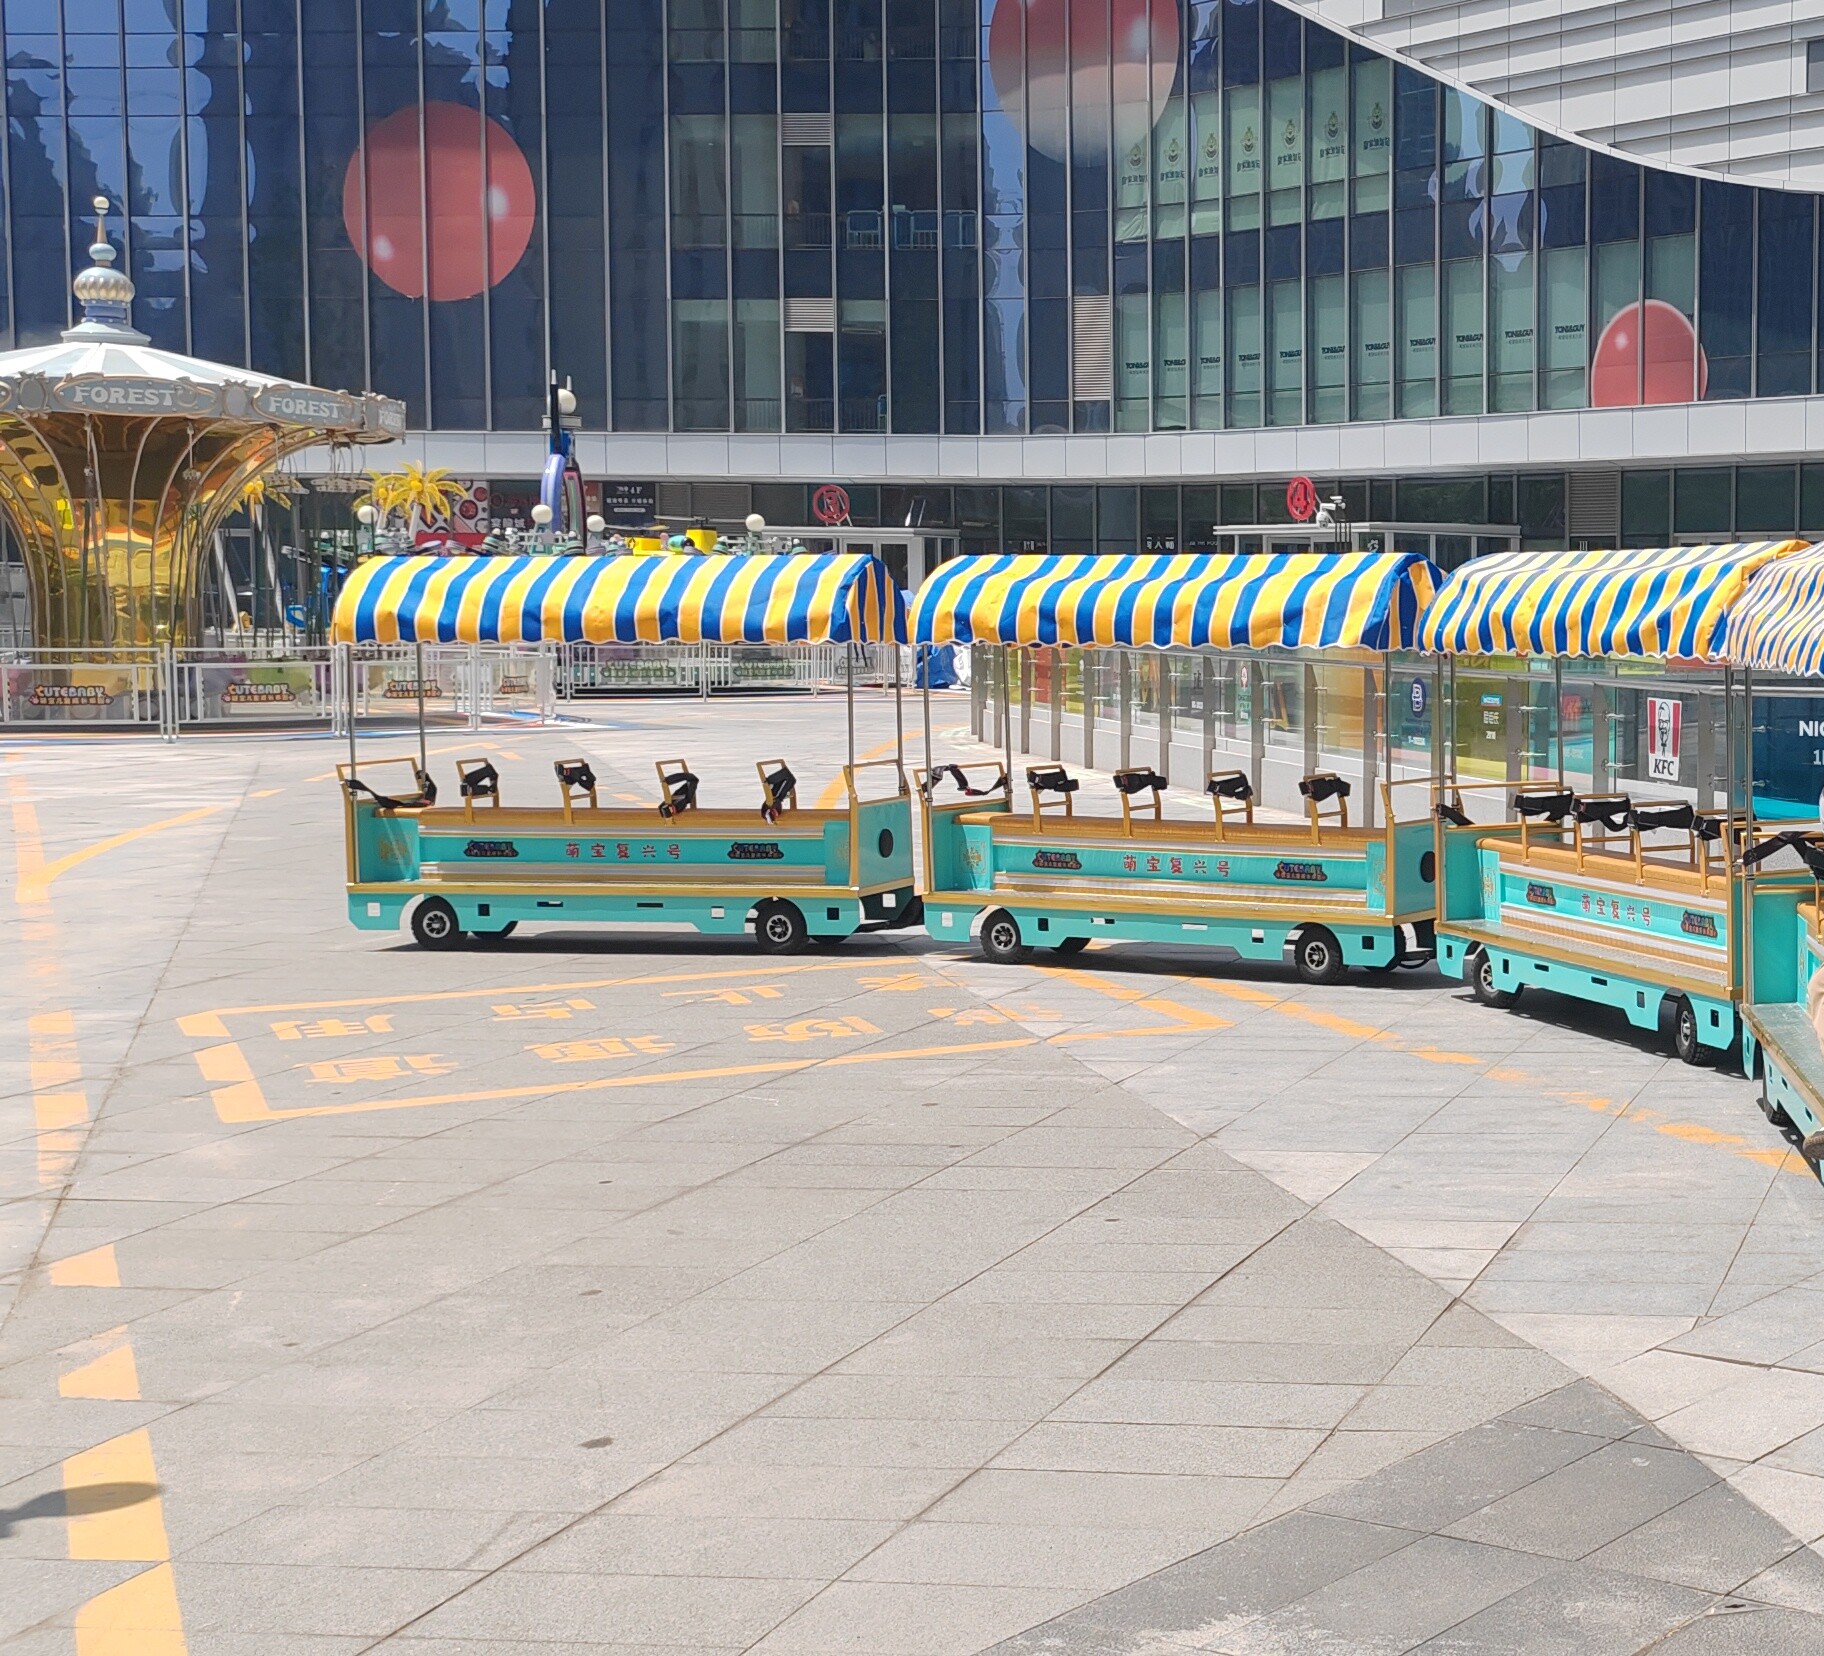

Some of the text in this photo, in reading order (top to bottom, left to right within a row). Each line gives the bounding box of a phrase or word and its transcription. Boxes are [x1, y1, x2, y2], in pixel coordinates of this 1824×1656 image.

[72, 384, 177, 406] FOREST
[269, 397, 342, 419] FOREST
[35, 686, 104, 698] CUTEBABY
[228, 683, 289, 695] CUTEBABY
[388, 680, 437, 691] CUTEBBY
[1653, 758, 1674, 776] KFC
[1123, 854, 1231, 877] 萌宝复兴号
